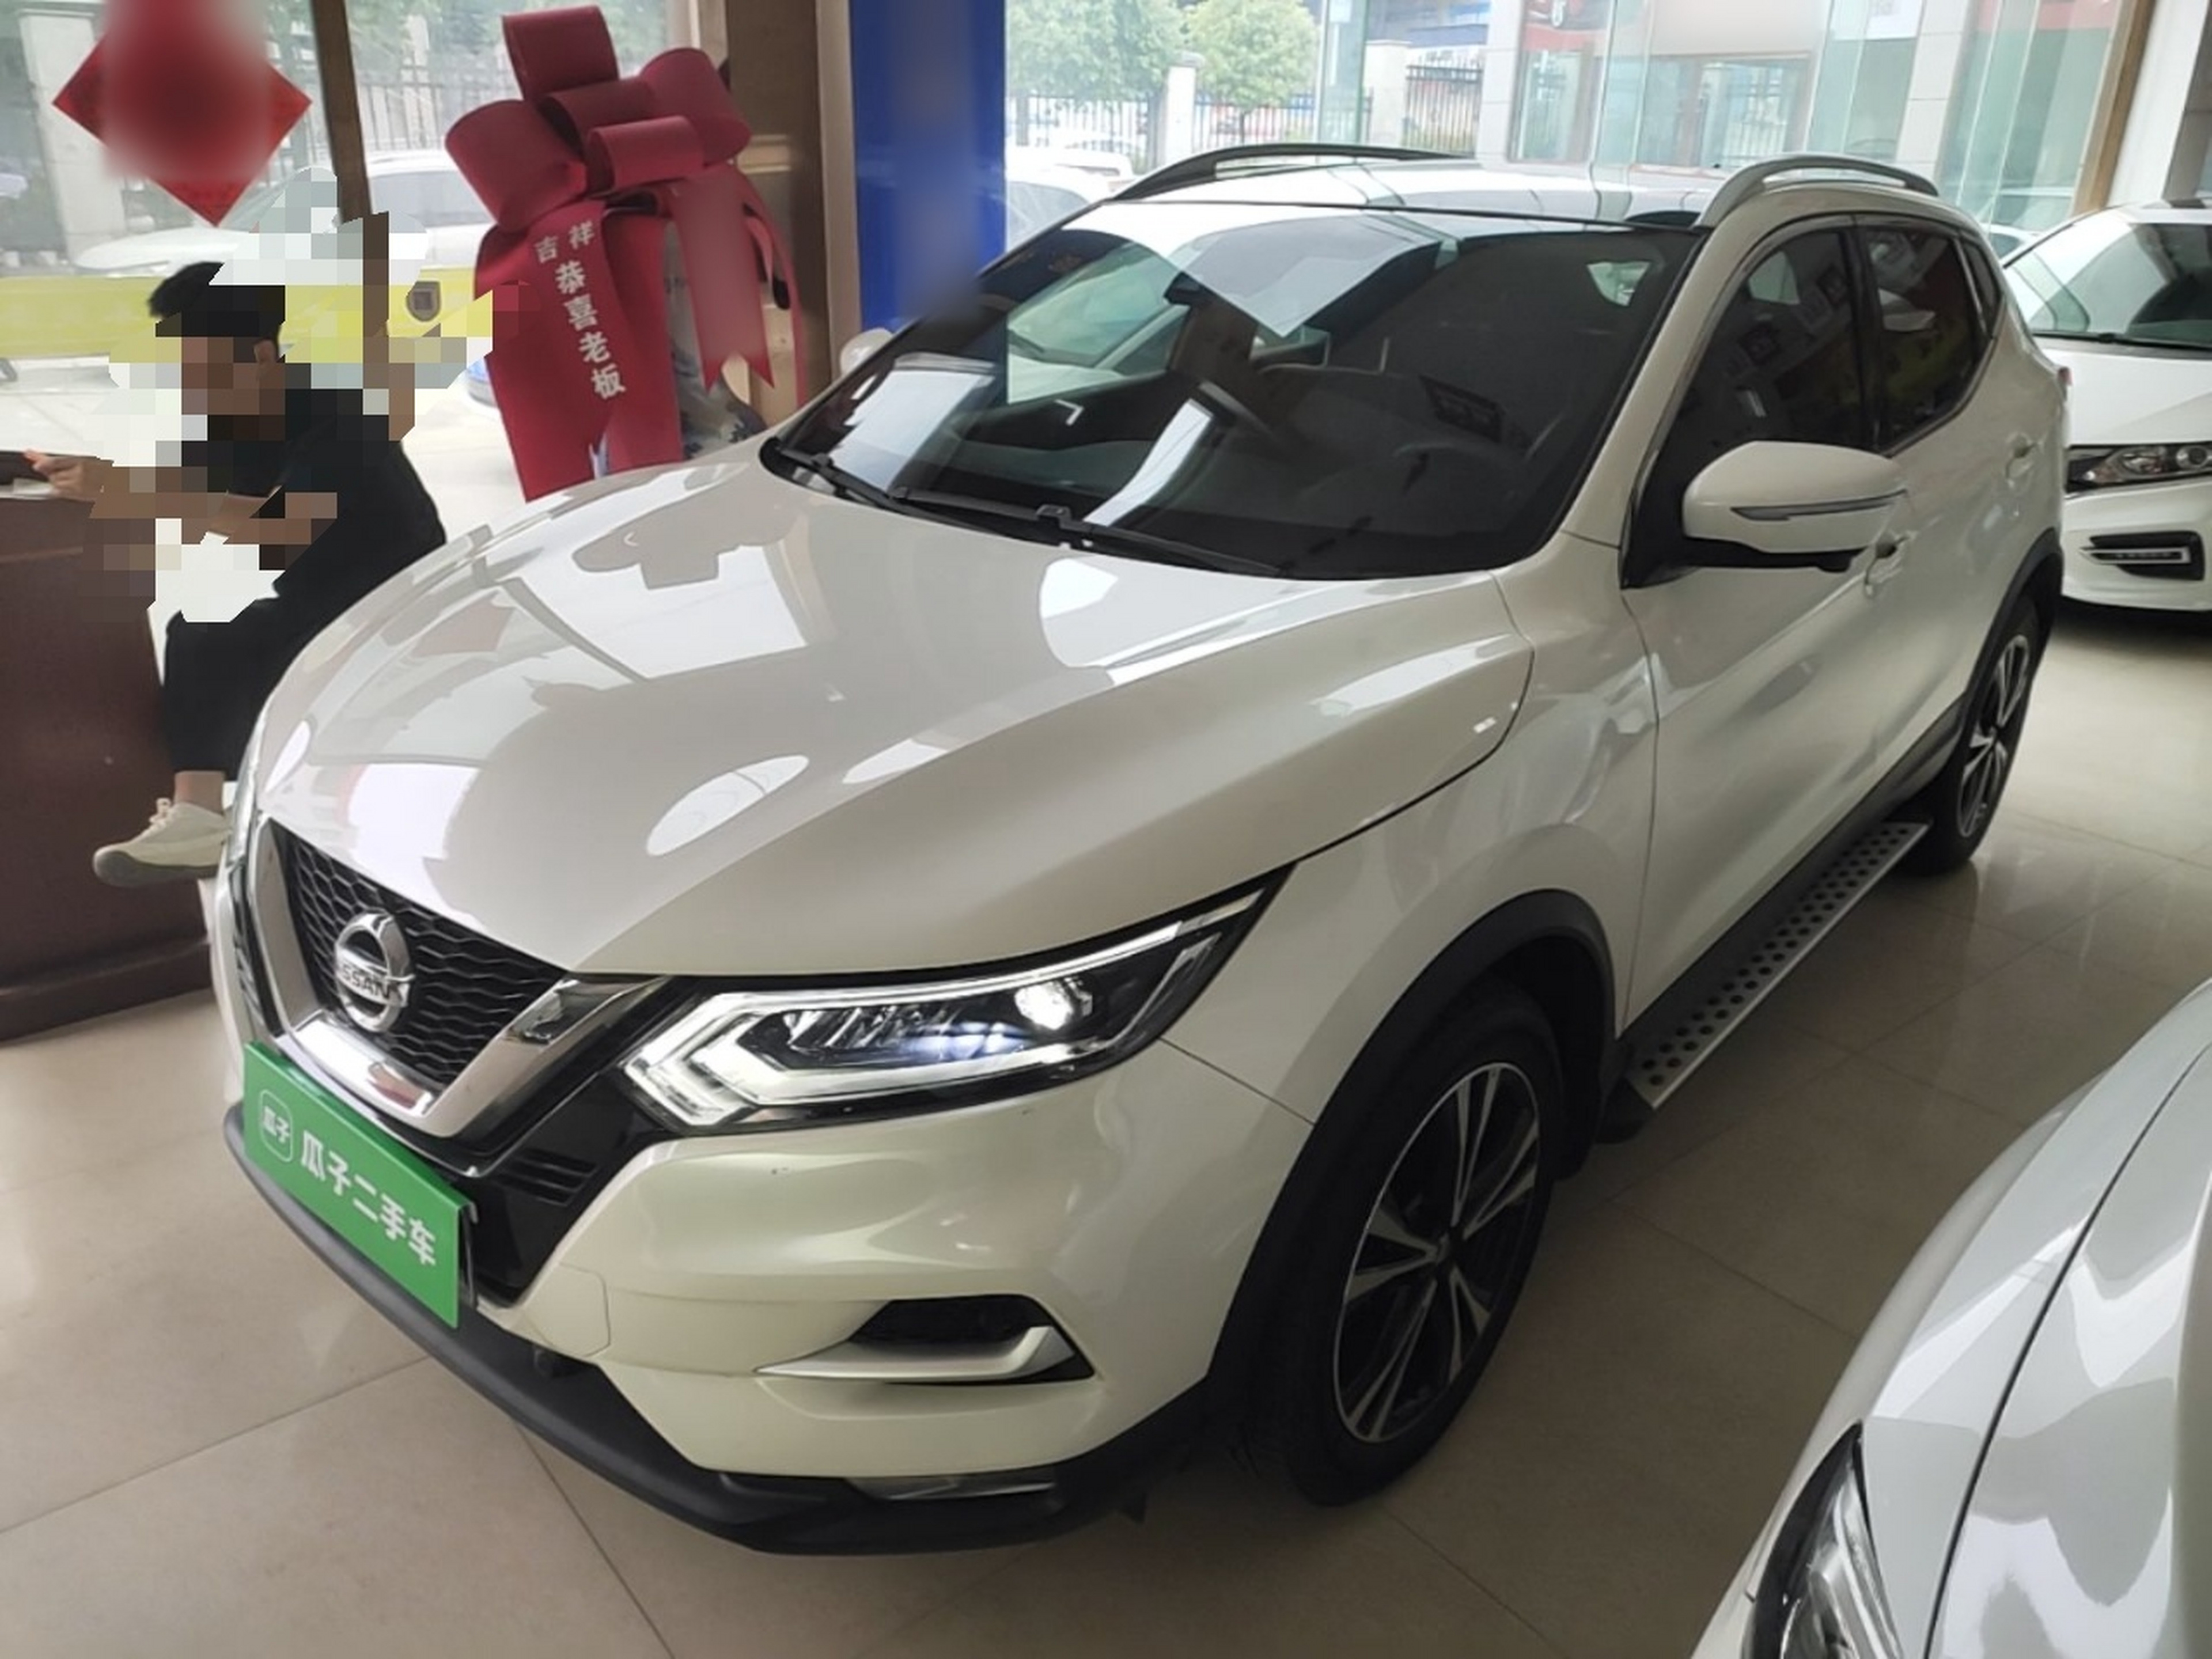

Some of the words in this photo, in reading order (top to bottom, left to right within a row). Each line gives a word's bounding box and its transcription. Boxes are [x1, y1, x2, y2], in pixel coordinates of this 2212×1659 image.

[555, 260, 626, 400] 恭喜老板
[338, 961, 393, 1001] SSAN
[301, 1130, 436, 1266] 瓜子二手车
